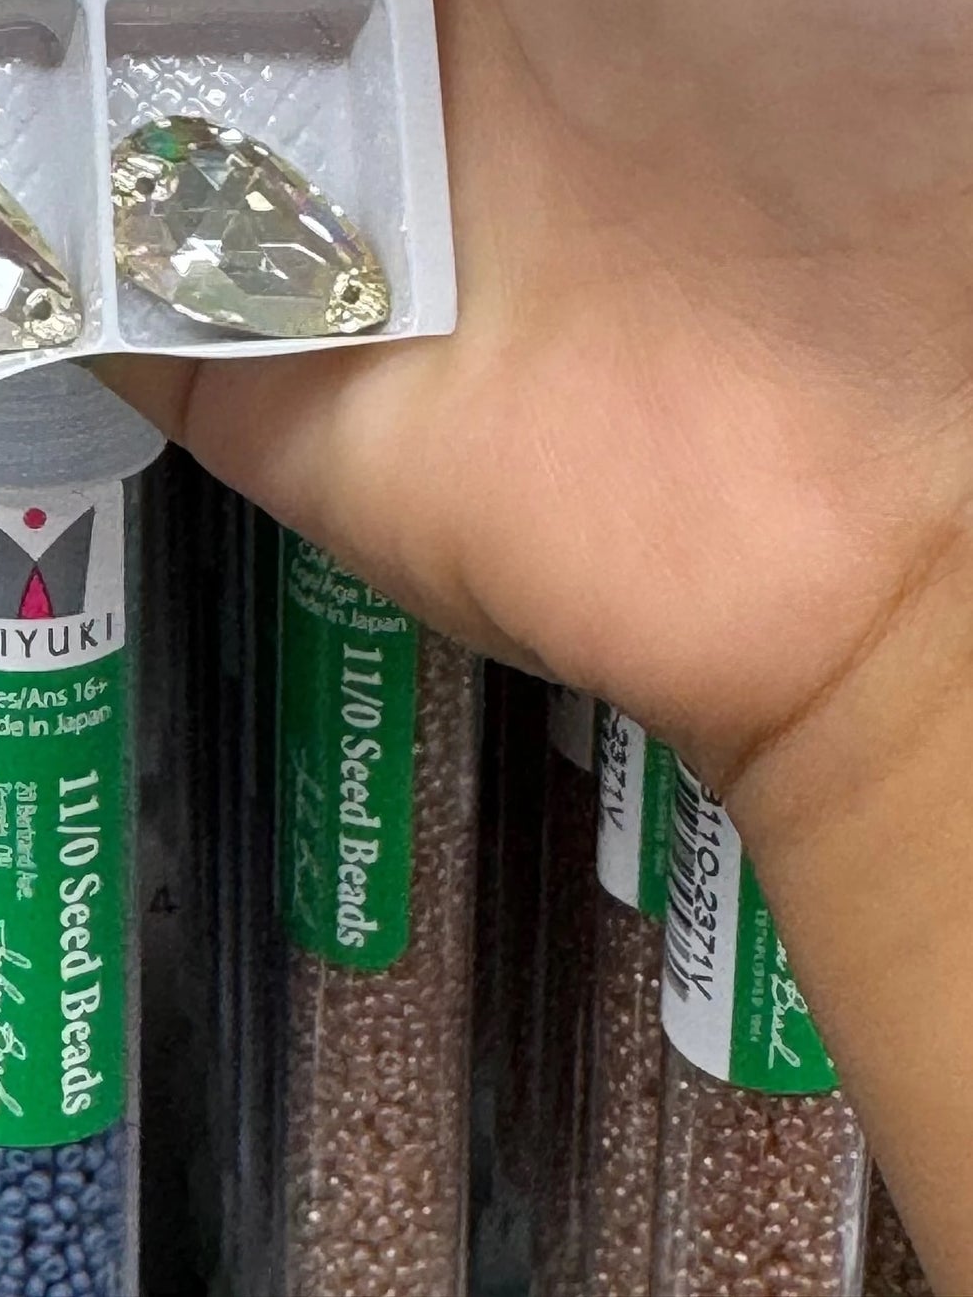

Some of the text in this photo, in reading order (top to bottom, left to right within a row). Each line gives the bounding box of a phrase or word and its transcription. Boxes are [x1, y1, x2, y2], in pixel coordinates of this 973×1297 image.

[53, 705, 112, 735] Japan
[73, 677, 108, 702] 16+
[337, 643, 384, 948] 11/0 Seed Beads
[56, 769, 104, 1115] 11/0 Seed Beads
